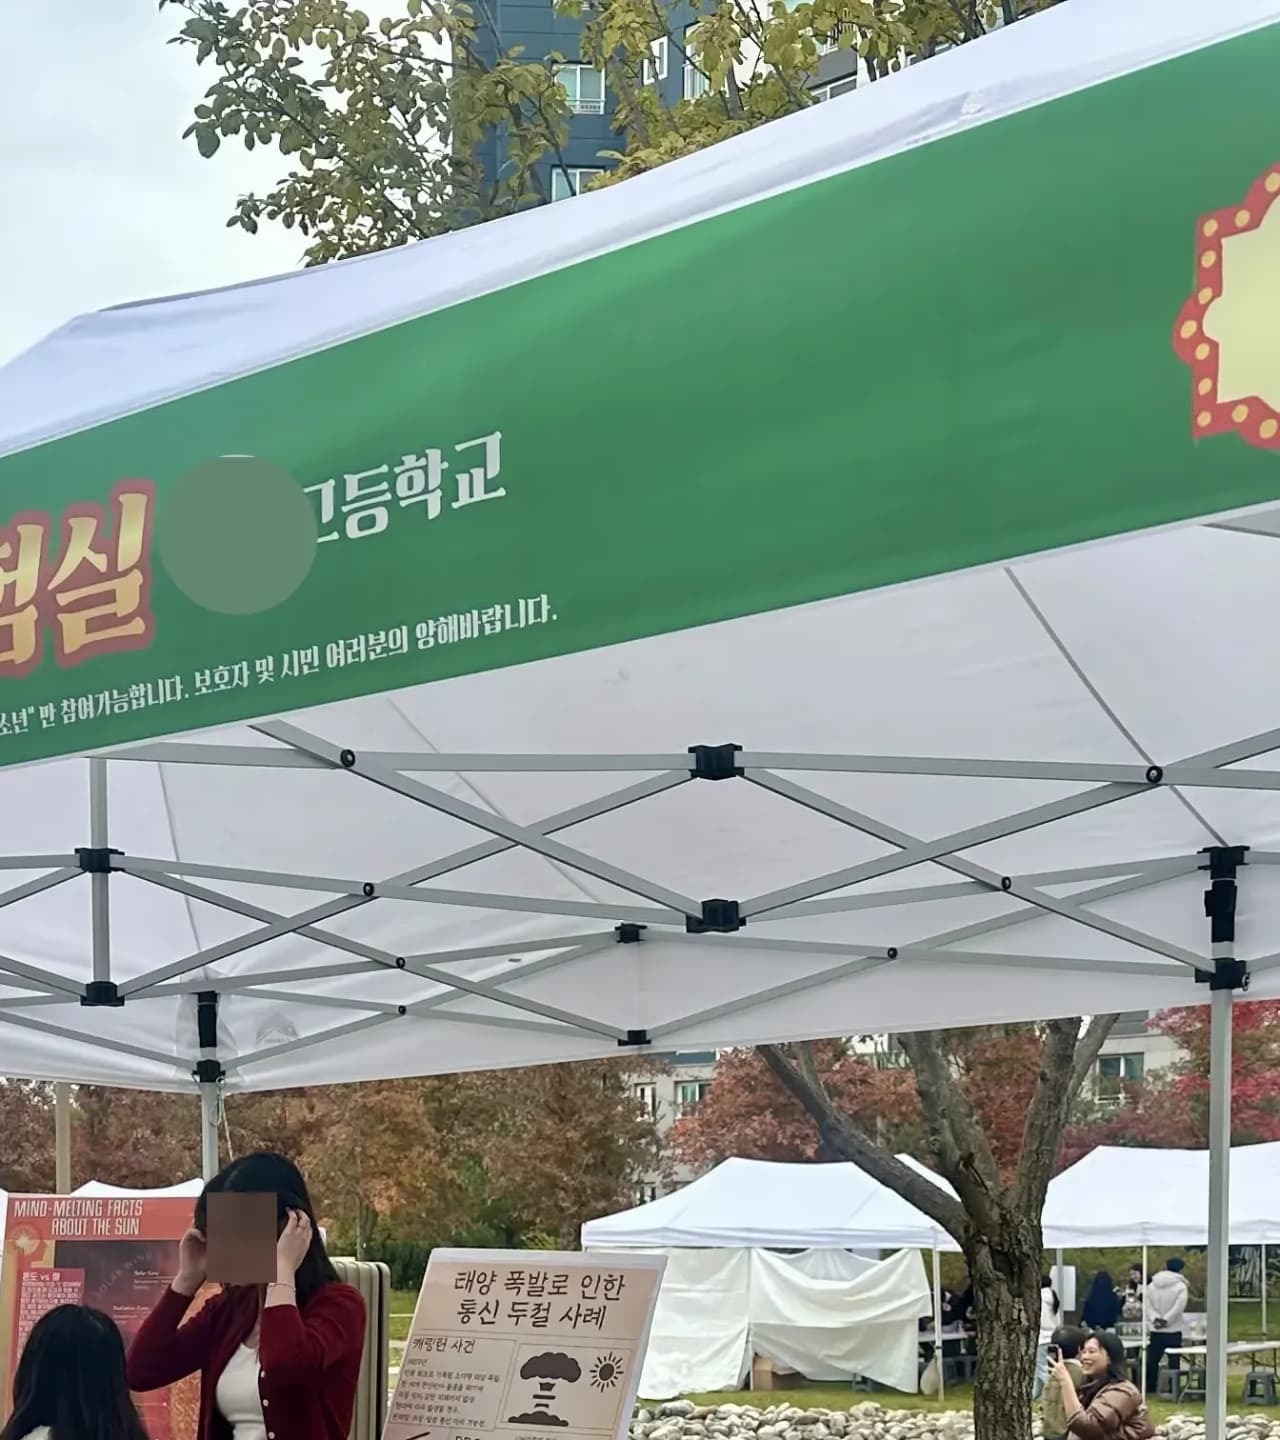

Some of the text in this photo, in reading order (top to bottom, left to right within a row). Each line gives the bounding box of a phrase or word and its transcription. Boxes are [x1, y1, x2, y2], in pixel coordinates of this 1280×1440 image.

[39, 703, 56, 728] 만
[60, 674, 190, 726] 참여가능합니다.
[194, 661, 250, 696] 보호자
[255, 655, 275, 685] 및
[280, 646, 320, 678] 시민
[326, 625, 408, 669] 여러분의
[415, 593, 558, 650] 양해바랍니다.
[14, 1200, 143, 1217] MIND-MELTING FACTS
[52, 1218, 140, 1236] ABOUT THE SUN
[454, 1269, 626, 1301] 태양 폭발로 인한
[457, 1299, 607, 1330] 통신 두절 사례
[451, 1338, 476, 1354] 사건
